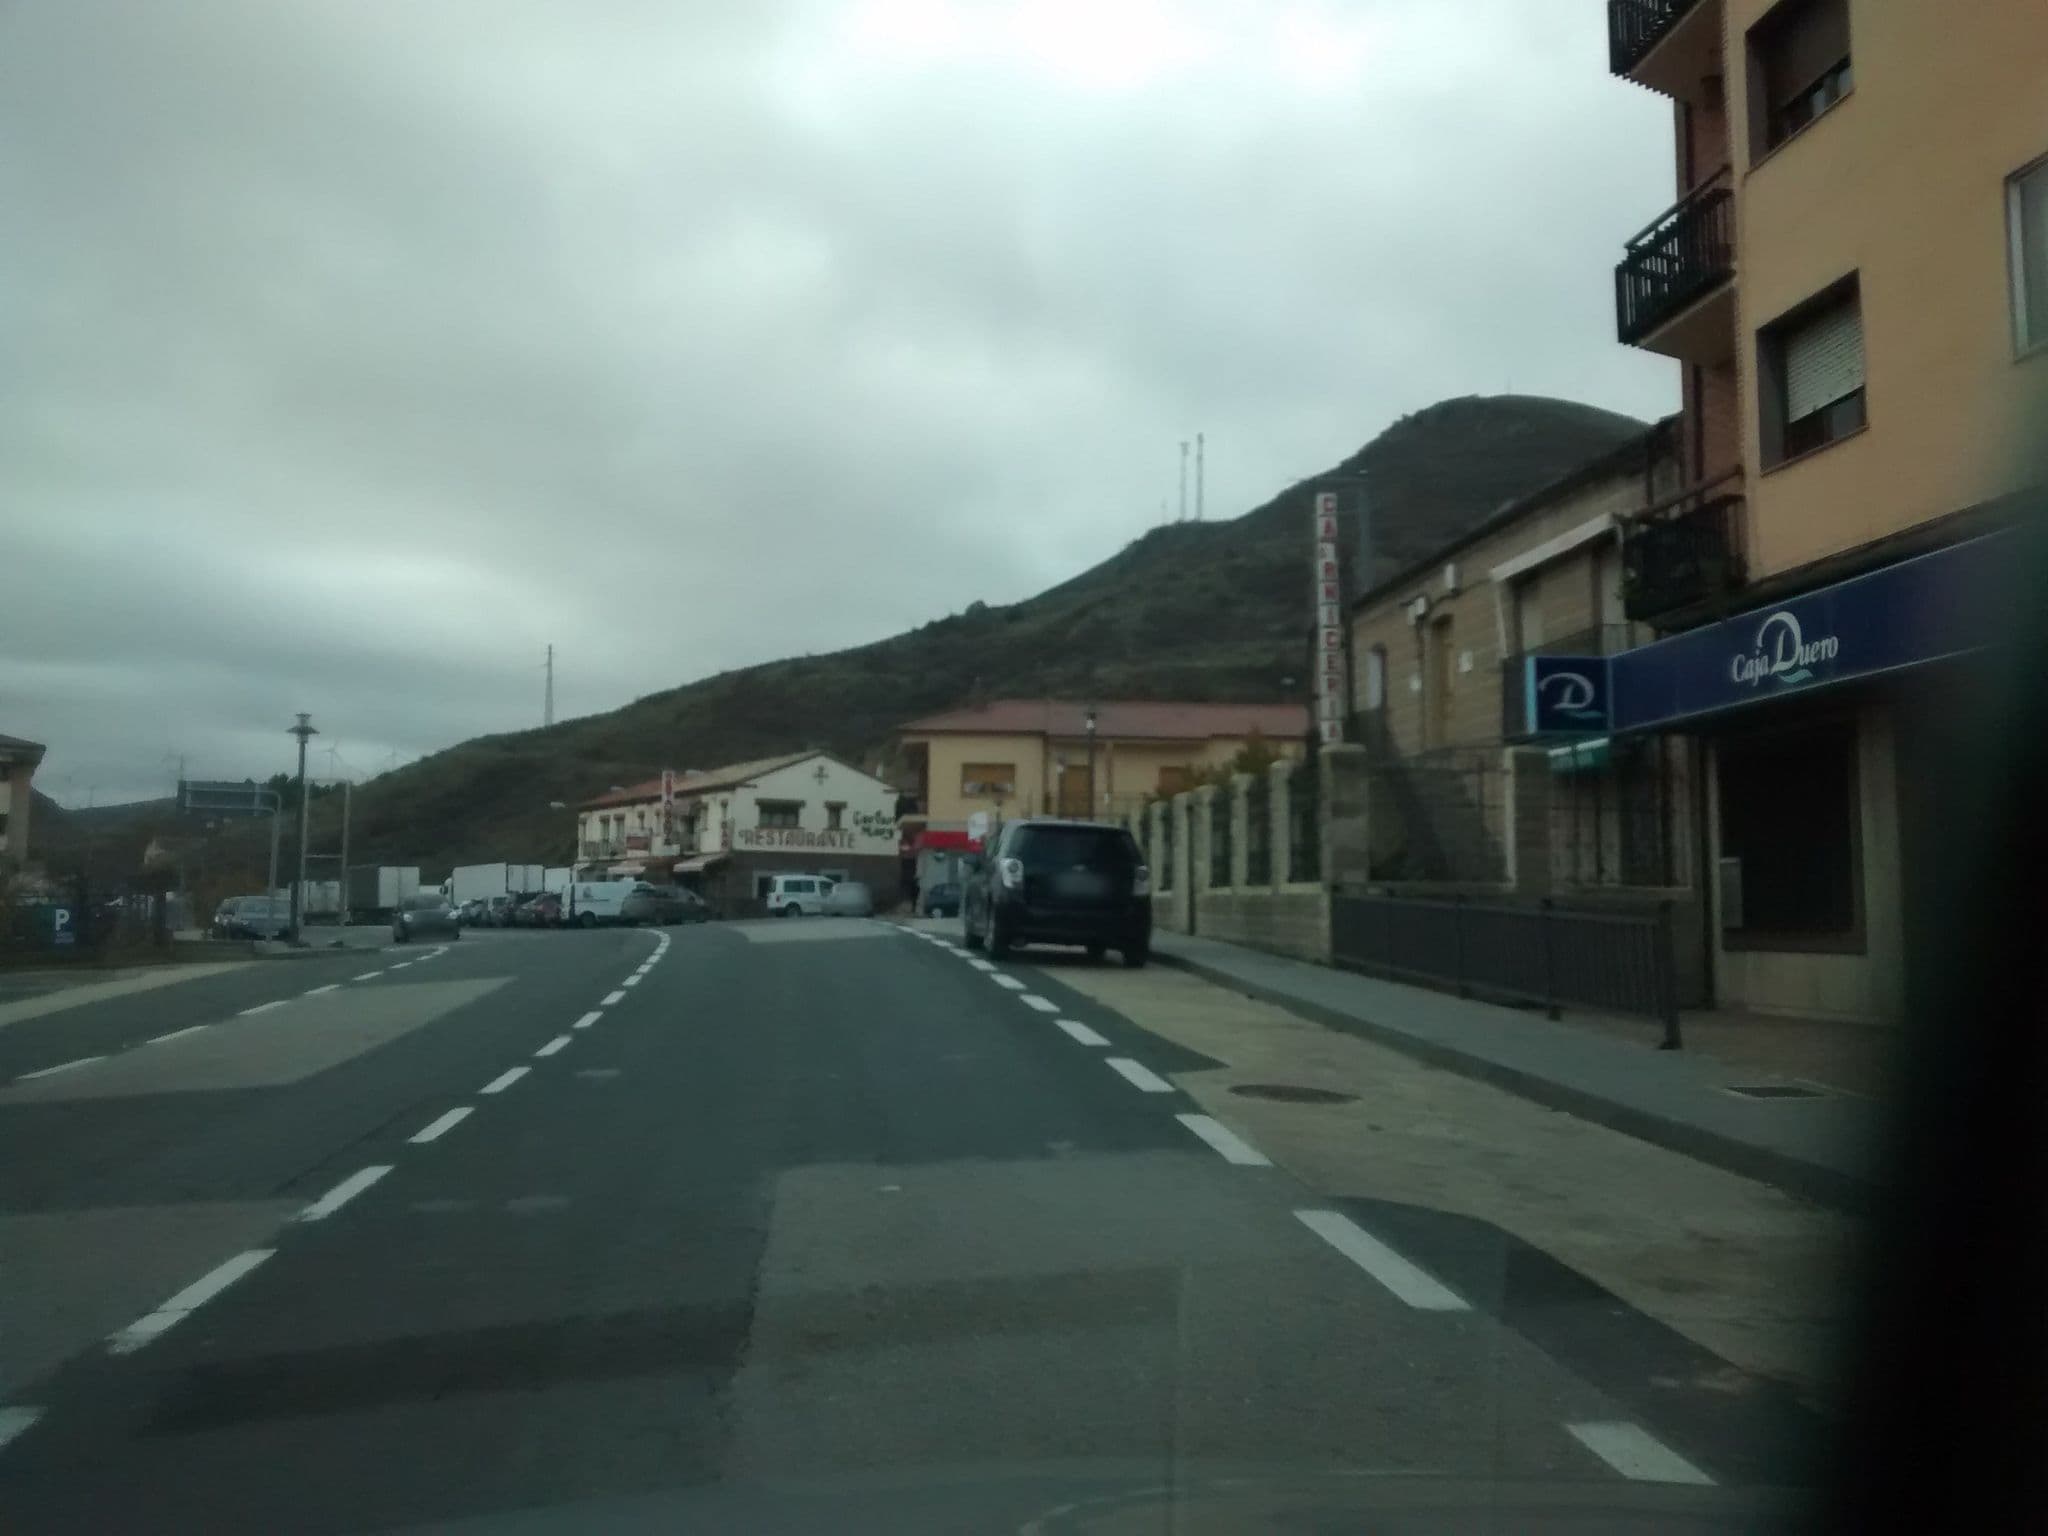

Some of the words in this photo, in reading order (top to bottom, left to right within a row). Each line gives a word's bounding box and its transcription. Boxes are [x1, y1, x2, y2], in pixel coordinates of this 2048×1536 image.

[1732, 653, 1769, 687] Caja
[1757, 611, 1839, 672] Duero
[740, 829, 856, 849] RESTAURANTE
[55, 909, 70, 931] P
